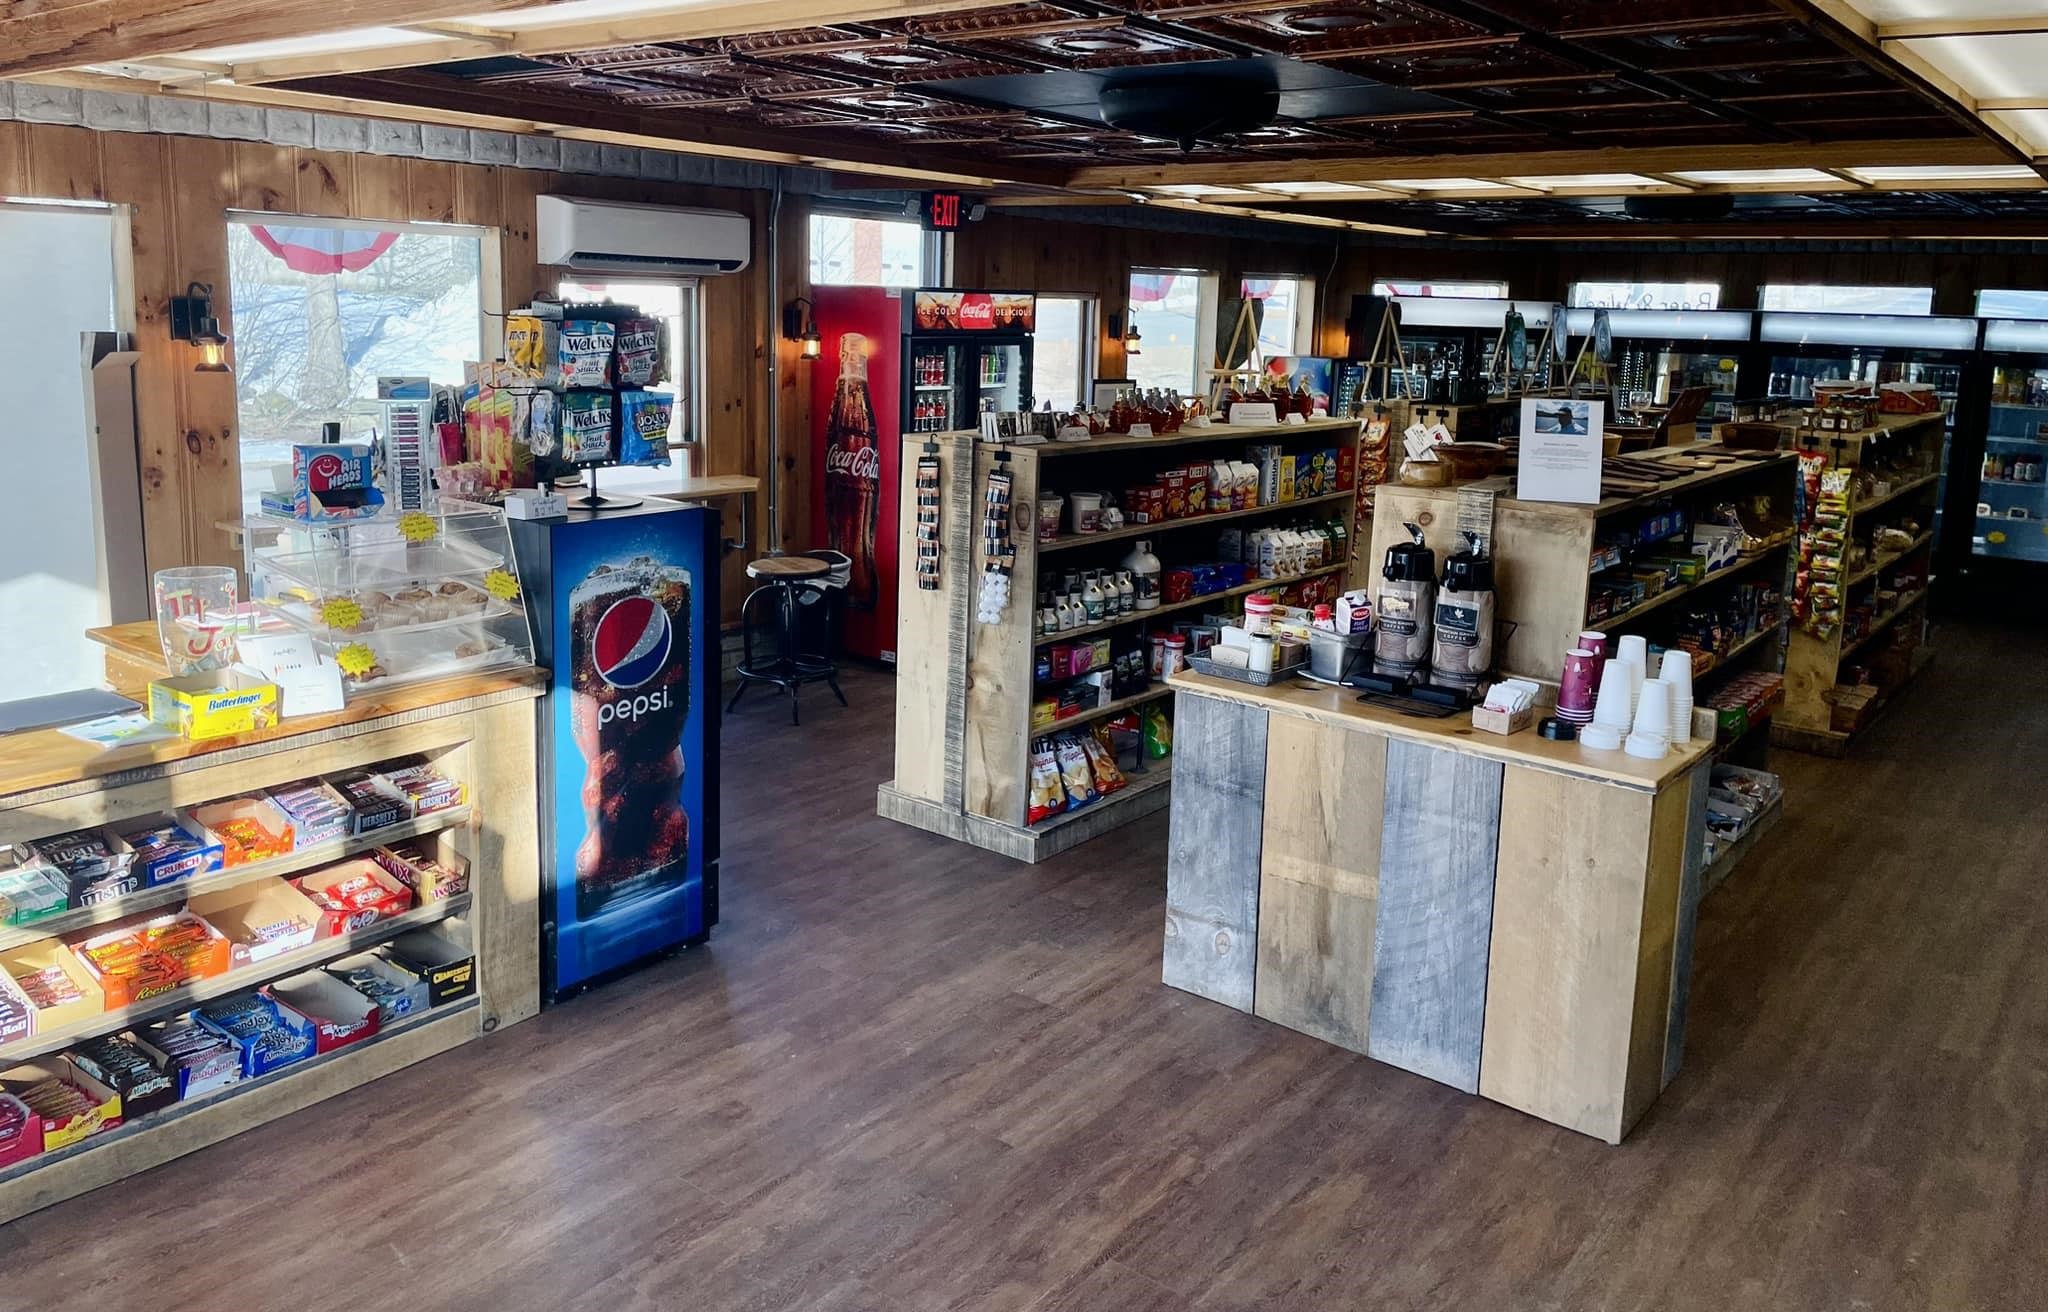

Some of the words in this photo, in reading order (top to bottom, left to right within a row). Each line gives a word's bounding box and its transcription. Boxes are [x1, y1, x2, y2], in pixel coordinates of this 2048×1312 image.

[933, 194, 960, 227] EXIT
[917, 307, 931, 316] ICE
[934, 307, 957, 316] COLD
[995, 308, 1033, 317] DELICIOUS
[568, 336, 613, 352] Welch's
[620, 333, 656, 351] Welch's
[573, 410, 612, 428] Welch's
[640, 412, 666, 427] JOLLY
[341, 458, 361, 473] AIR
[328, 470, 362, 489] HEADS
[187, 626, 235, 656] Jar
[208, 693, 262, 711] Butterfinger
[598, 685, 669, 730] pepsi
[362, 808, 398, 828] HERSHEY'S
[156, 855, 201, 878] CRUNCH
[2, 1019, 27, 1036] Roll
[333, 1018, 369, 1036] Mounds
